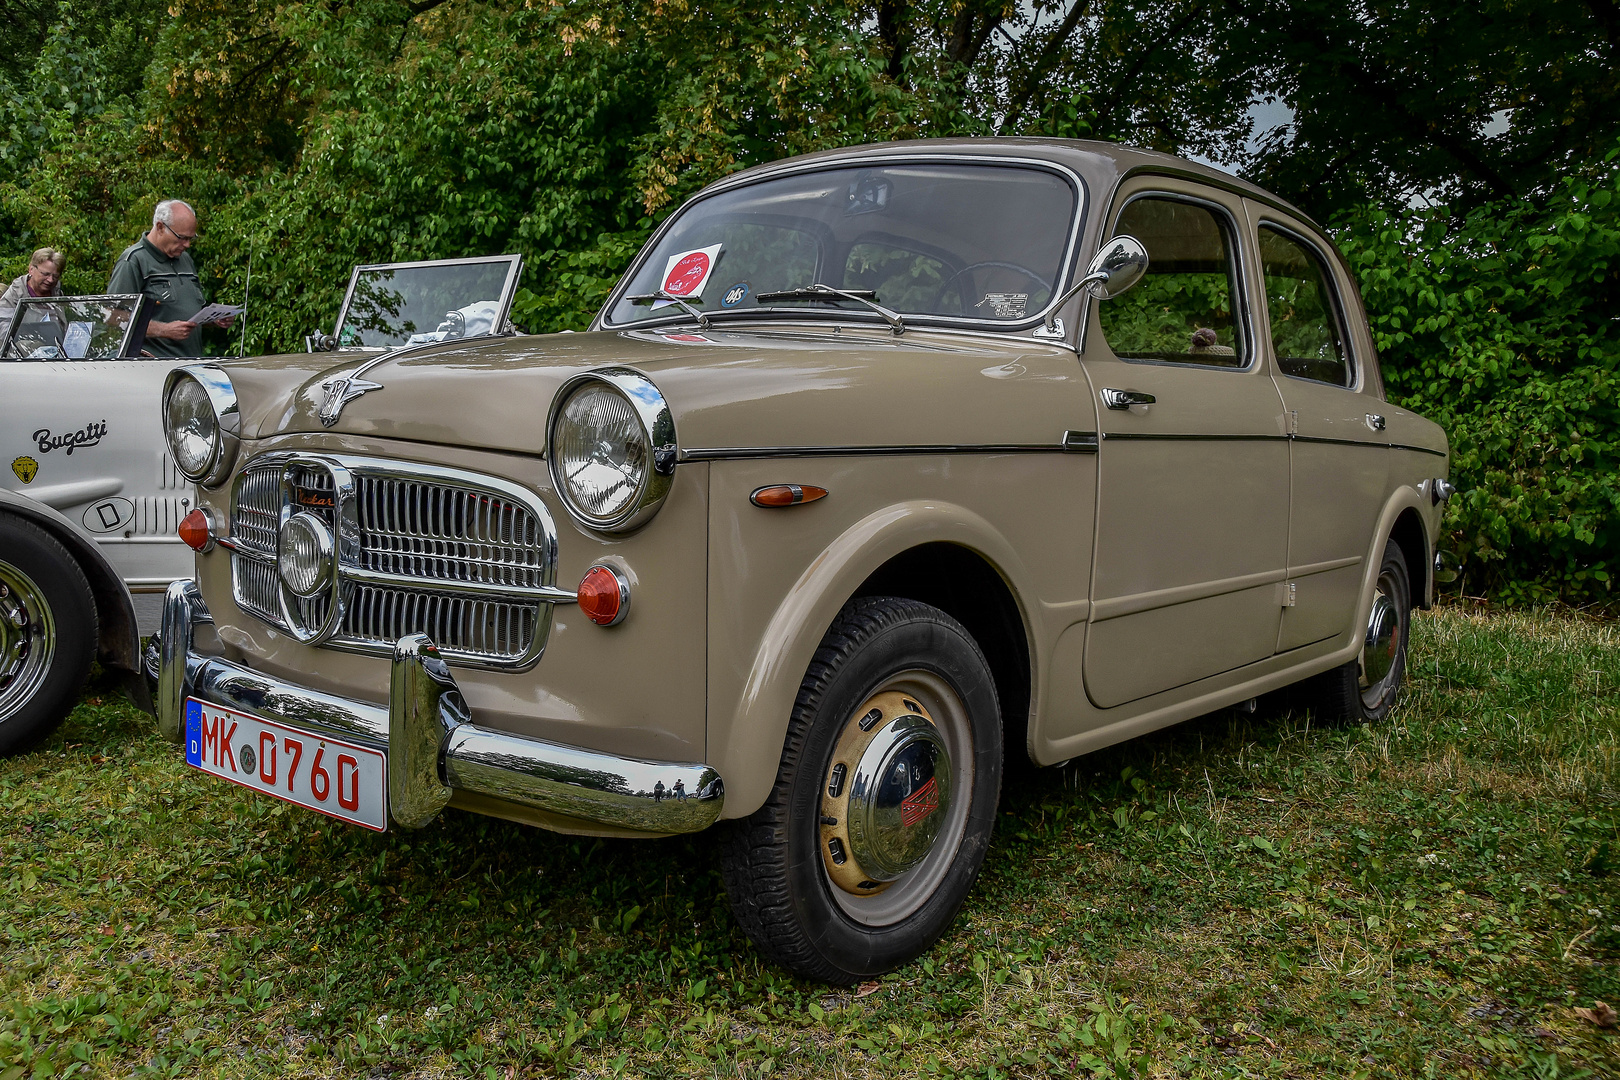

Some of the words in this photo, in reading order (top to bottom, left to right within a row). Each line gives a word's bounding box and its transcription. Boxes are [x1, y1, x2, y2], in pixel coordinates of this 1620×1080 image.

[33, 419, 108, 455] Bugatti
[298, 489, 335, 506] Neckar
[96, 503, 120, 528] D
[191, 740, 198, 754] D
[202, 711, 237, 772] MK
[259, 730, 359, 812] 0760
[794, 719, 829, 819] MICHELIN
